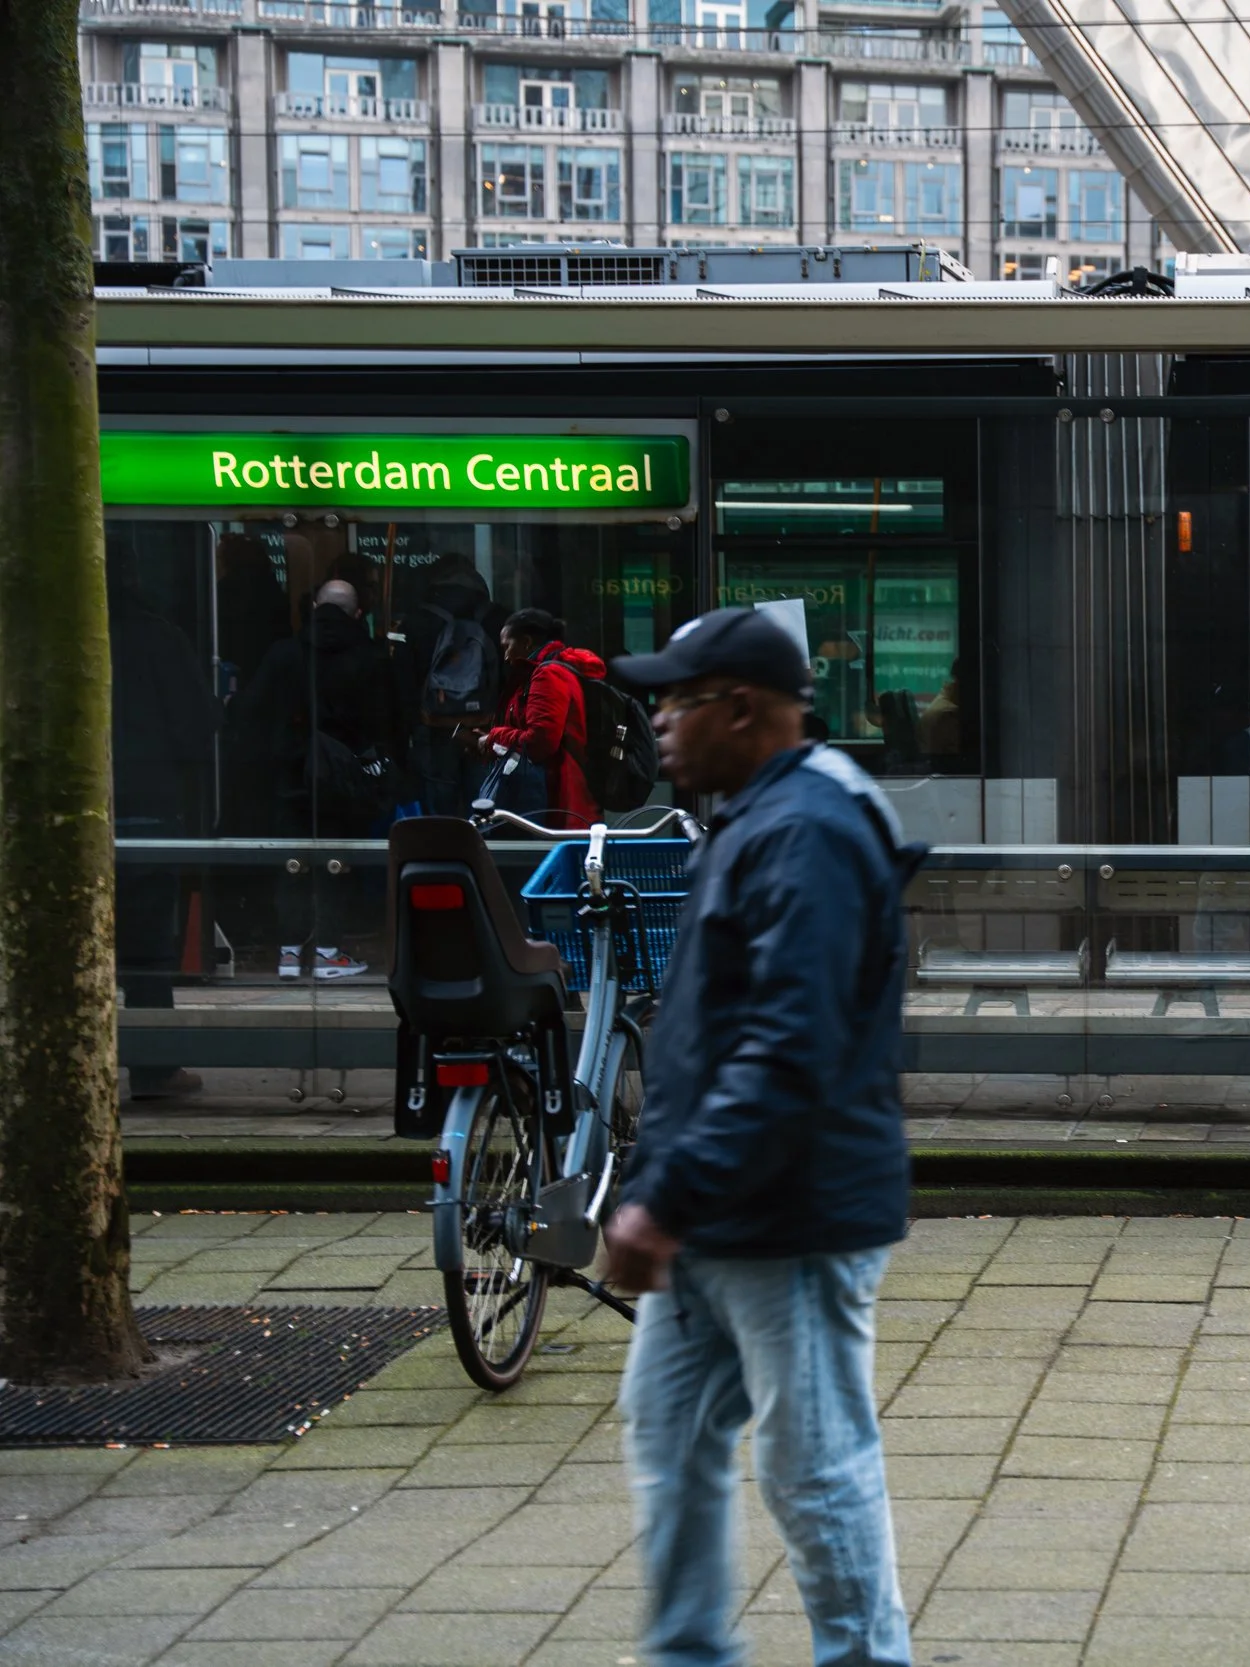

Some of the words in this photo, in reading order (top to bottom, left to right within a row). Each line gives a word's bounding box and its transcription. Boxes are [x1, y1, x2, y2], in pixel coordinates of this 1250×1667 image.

[212, 450, 451, 490] Rotterdam
[466, 453, 652, 492] Centraal
[381, 535, 410, 547] vor
